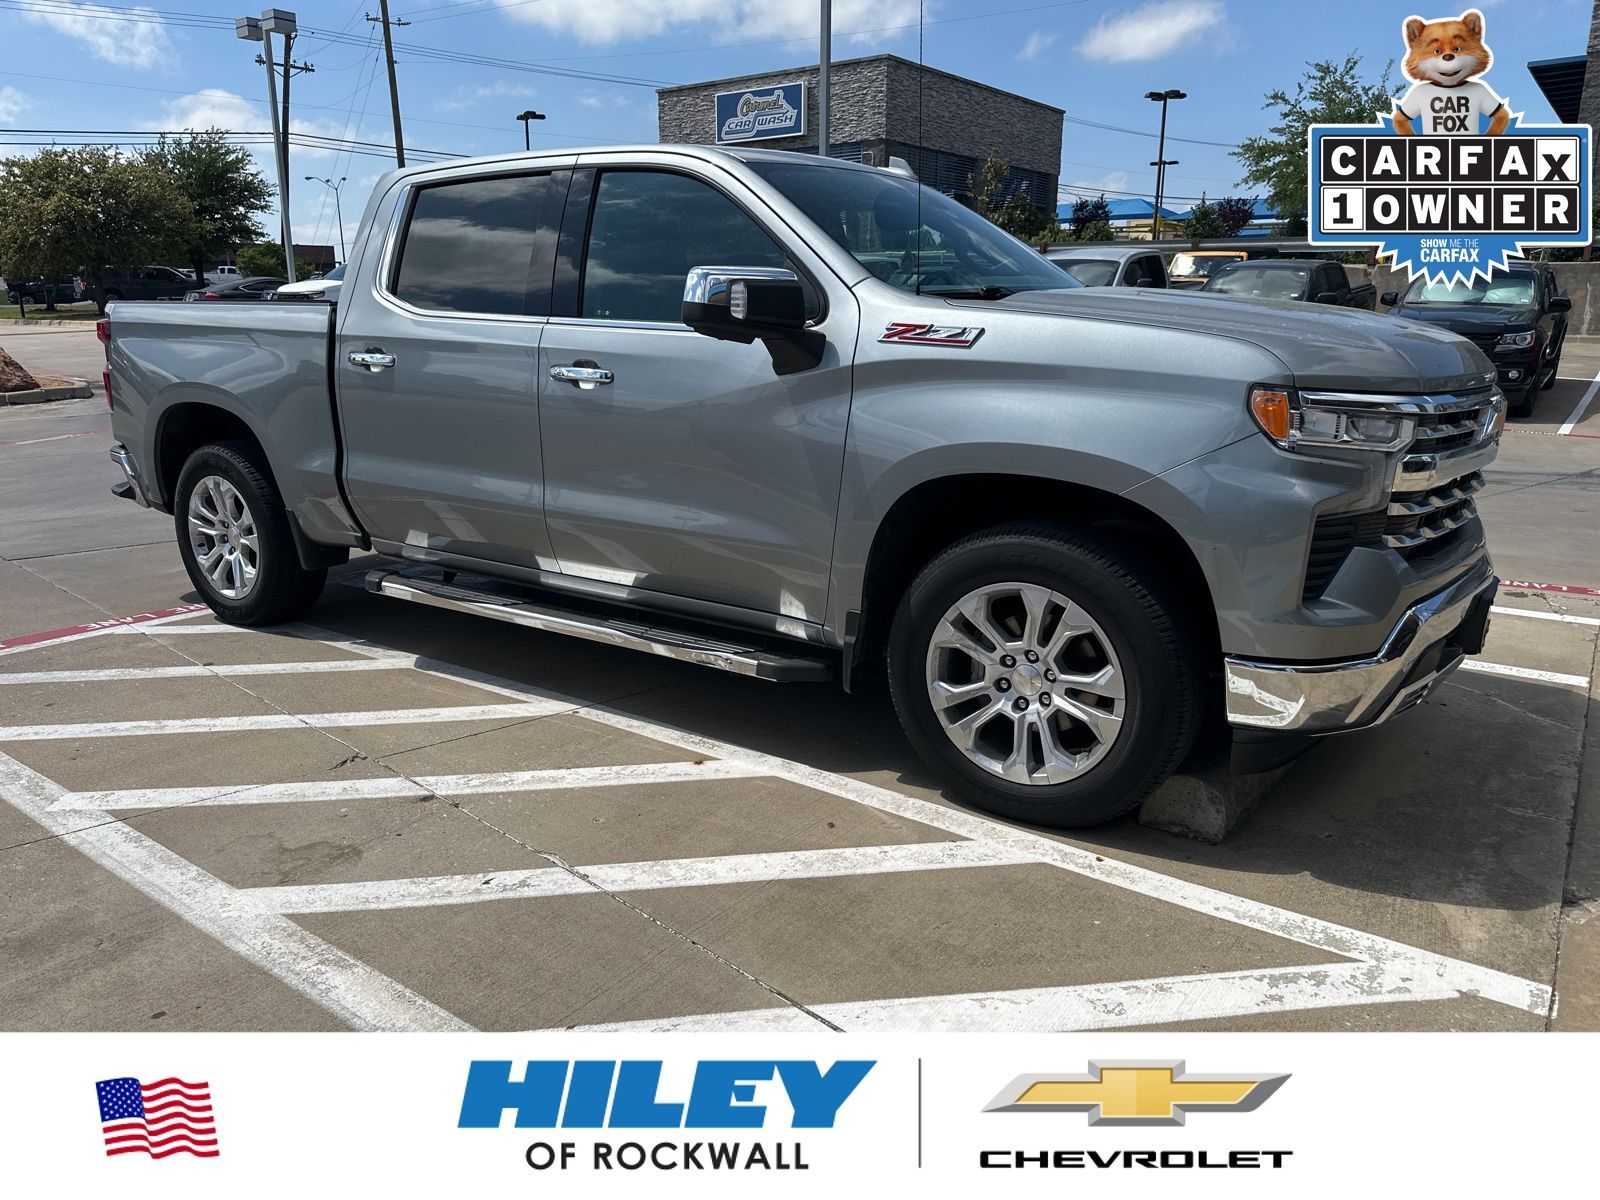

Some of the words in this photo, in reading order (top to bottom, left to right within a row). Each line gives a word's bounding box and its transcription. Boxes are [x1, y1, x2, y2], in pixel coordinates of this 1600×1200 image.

[740, 94, 784, 117] Carmel
[728, 119, 752, 130] CAR
[757, 113, 793, 126] WASH
[877, 322, 986, 349] Z71
